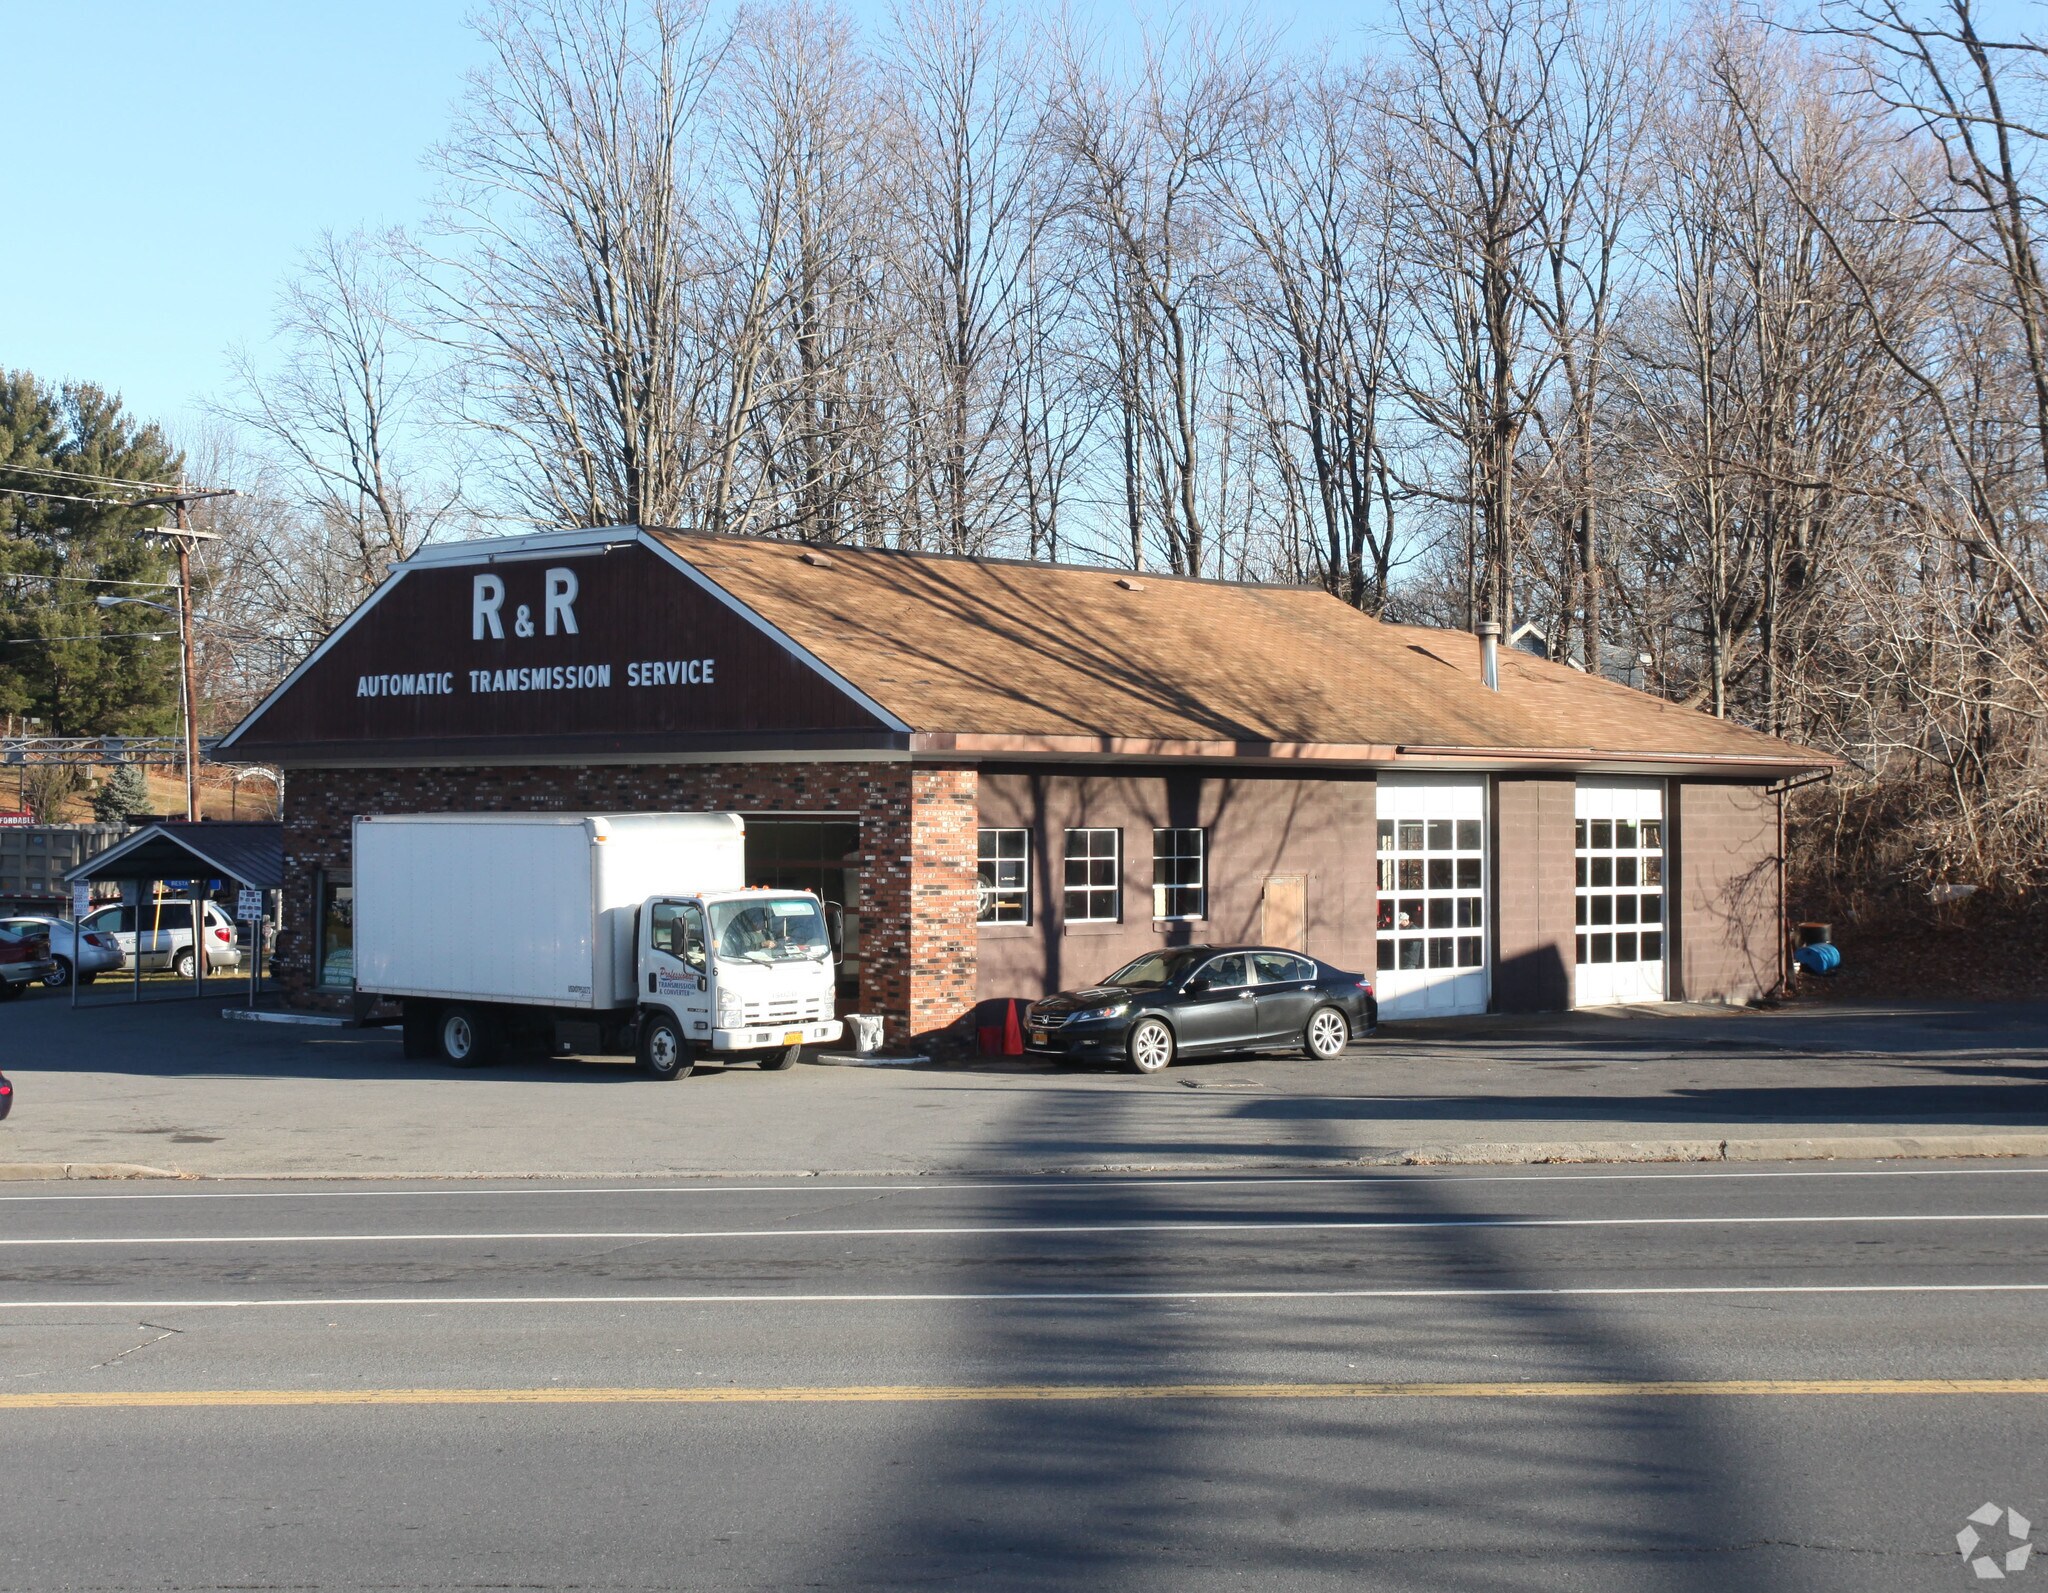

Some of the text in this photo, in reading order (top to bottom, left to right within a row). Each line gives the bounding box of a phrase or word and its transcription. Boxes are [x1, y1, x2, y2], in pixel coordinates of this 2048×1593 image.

[472, 566, 579, 640] R & R
[356, 659, 715, 697] AUTOMATIC TRANSMISSION SERVICE
[712, 966, 719, 977] 6
[658, 981, 696, 990] TRANSMISSION
[663, 988, 690, 996] CONVERTER
